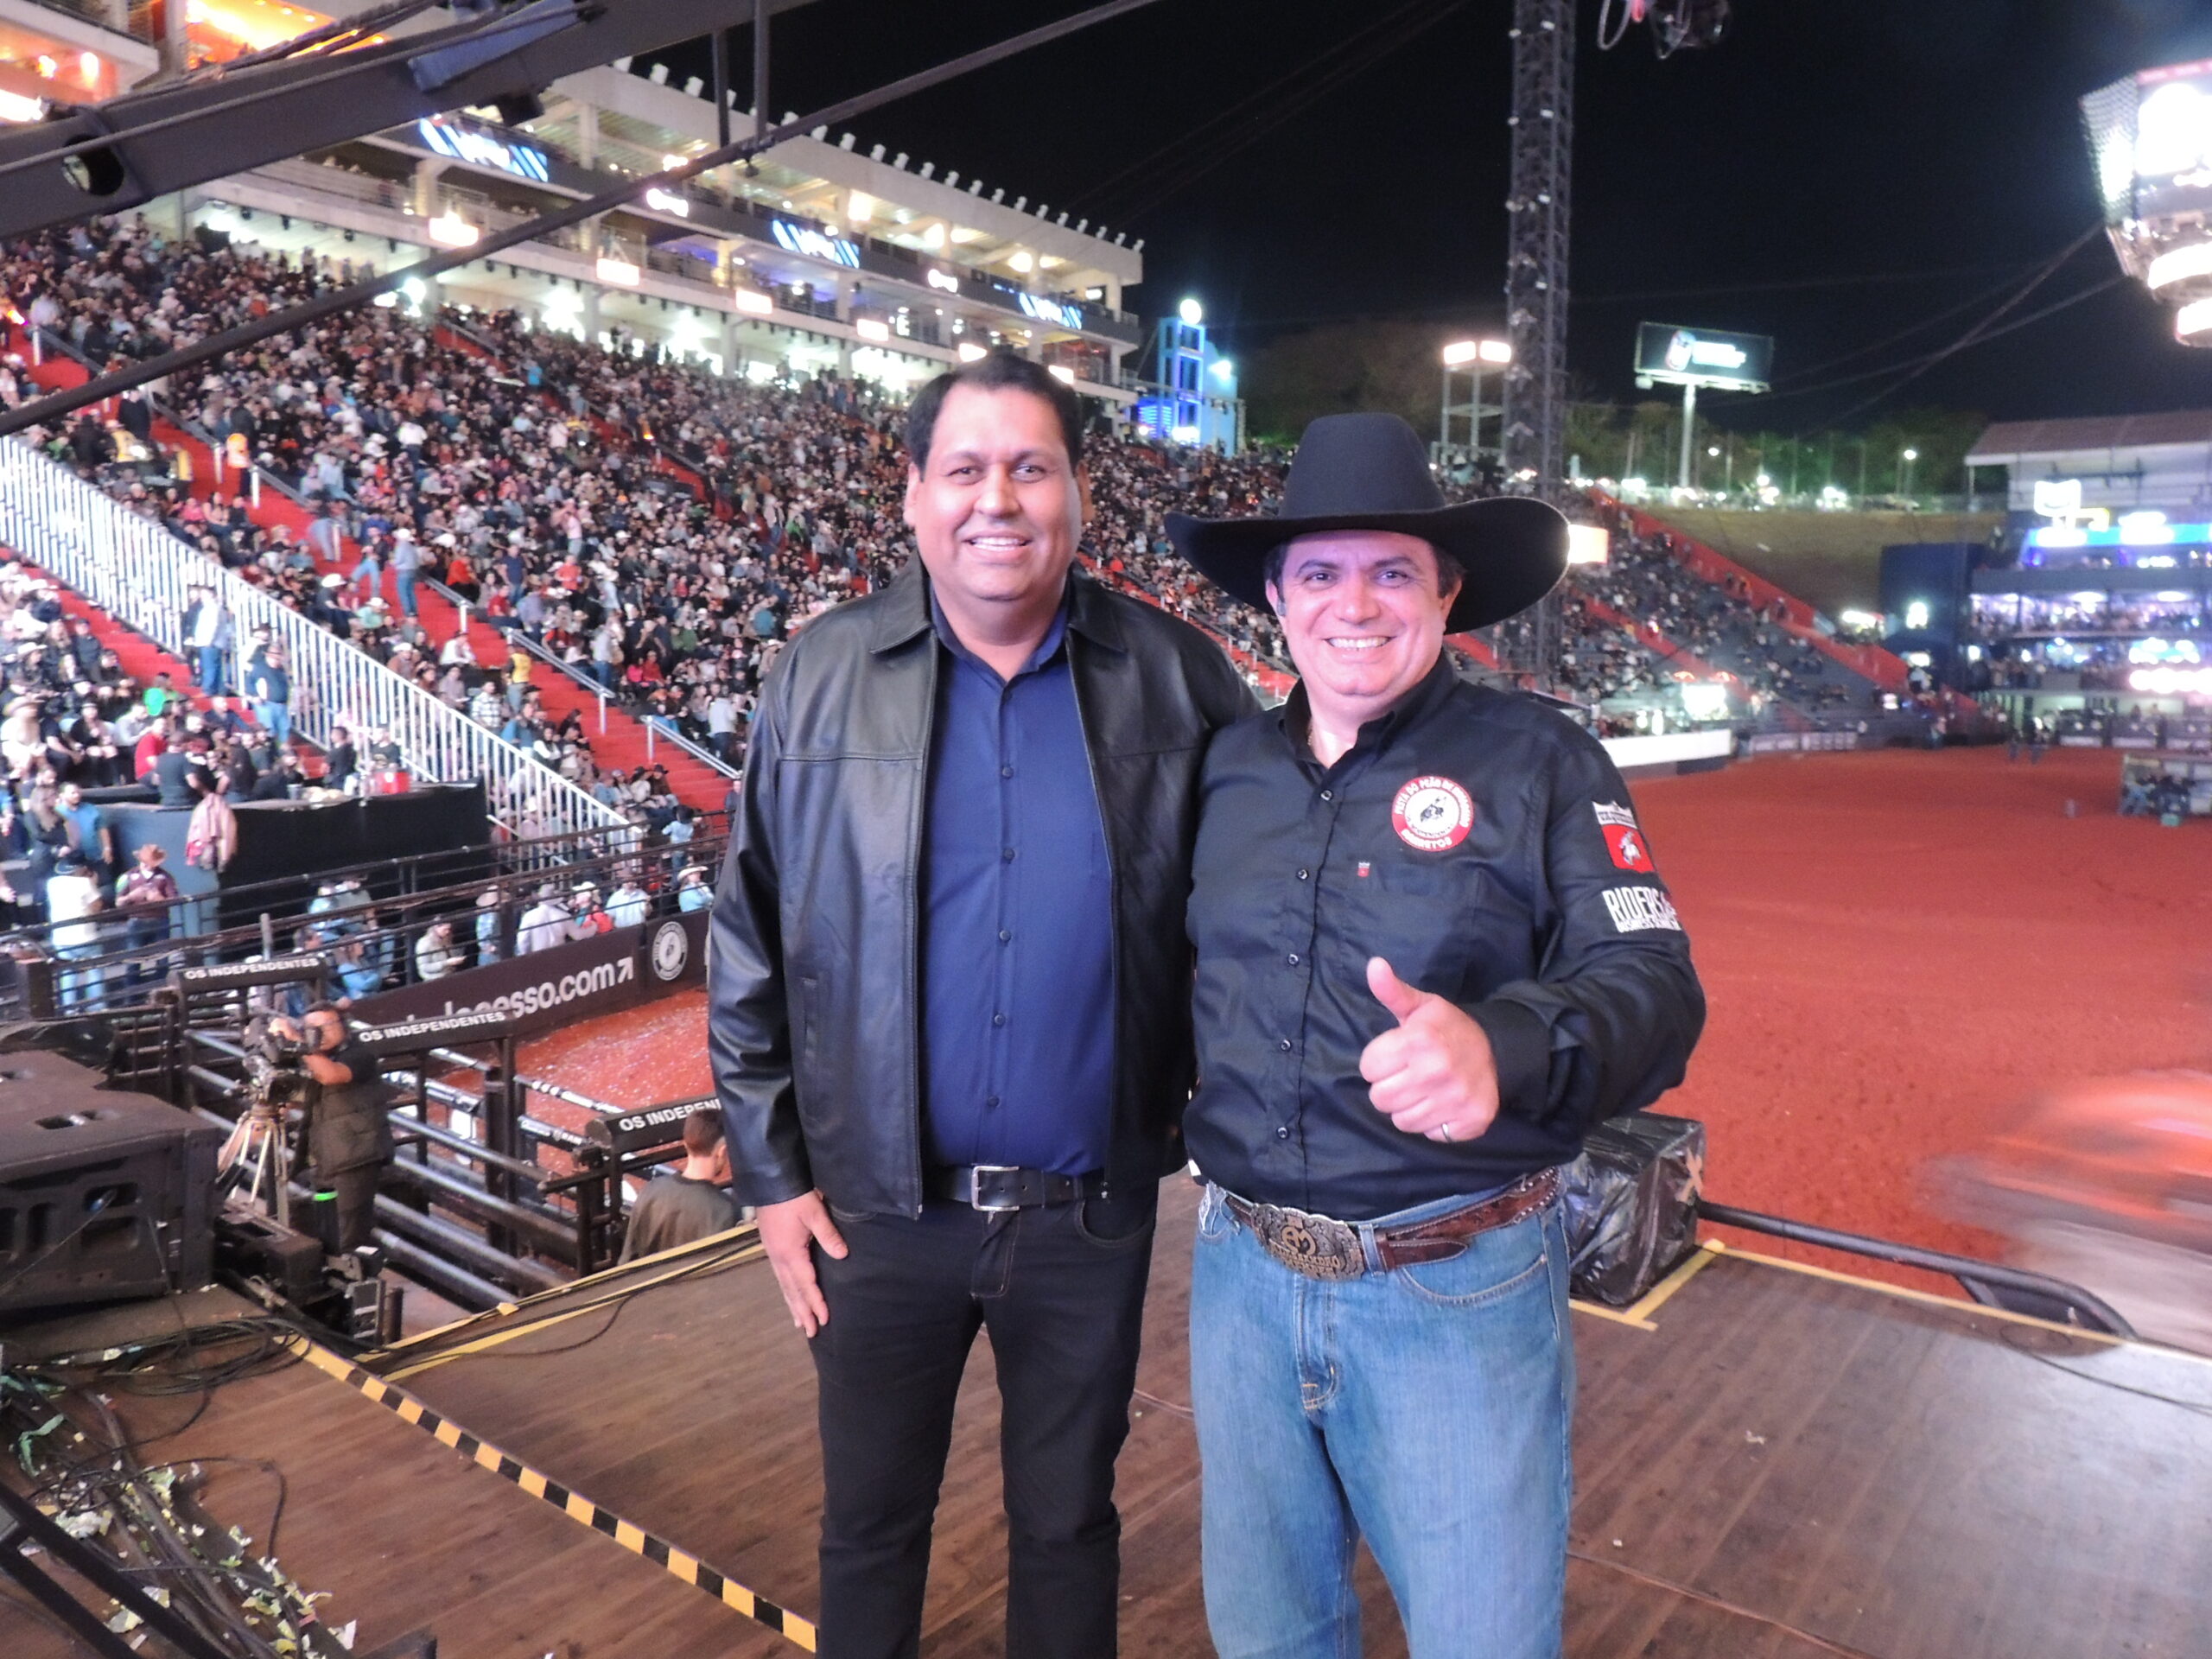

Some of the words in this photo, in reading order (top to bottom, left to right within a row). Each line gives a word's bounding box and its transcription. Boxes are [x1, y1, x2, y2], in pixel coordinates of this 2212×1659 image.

[1405, 782, 1420, 796] DO
[1602, 887, 1663, 921] RIDERS
[184, 969, 207, 980] OS
[208, 957, 320, 977] INDEPENDENTES
[359, 1030, 384, 1042] OS
[384, 1012, 506, 1039] INDEPENDENTES
[619, 1119, 646, 1132] OS
